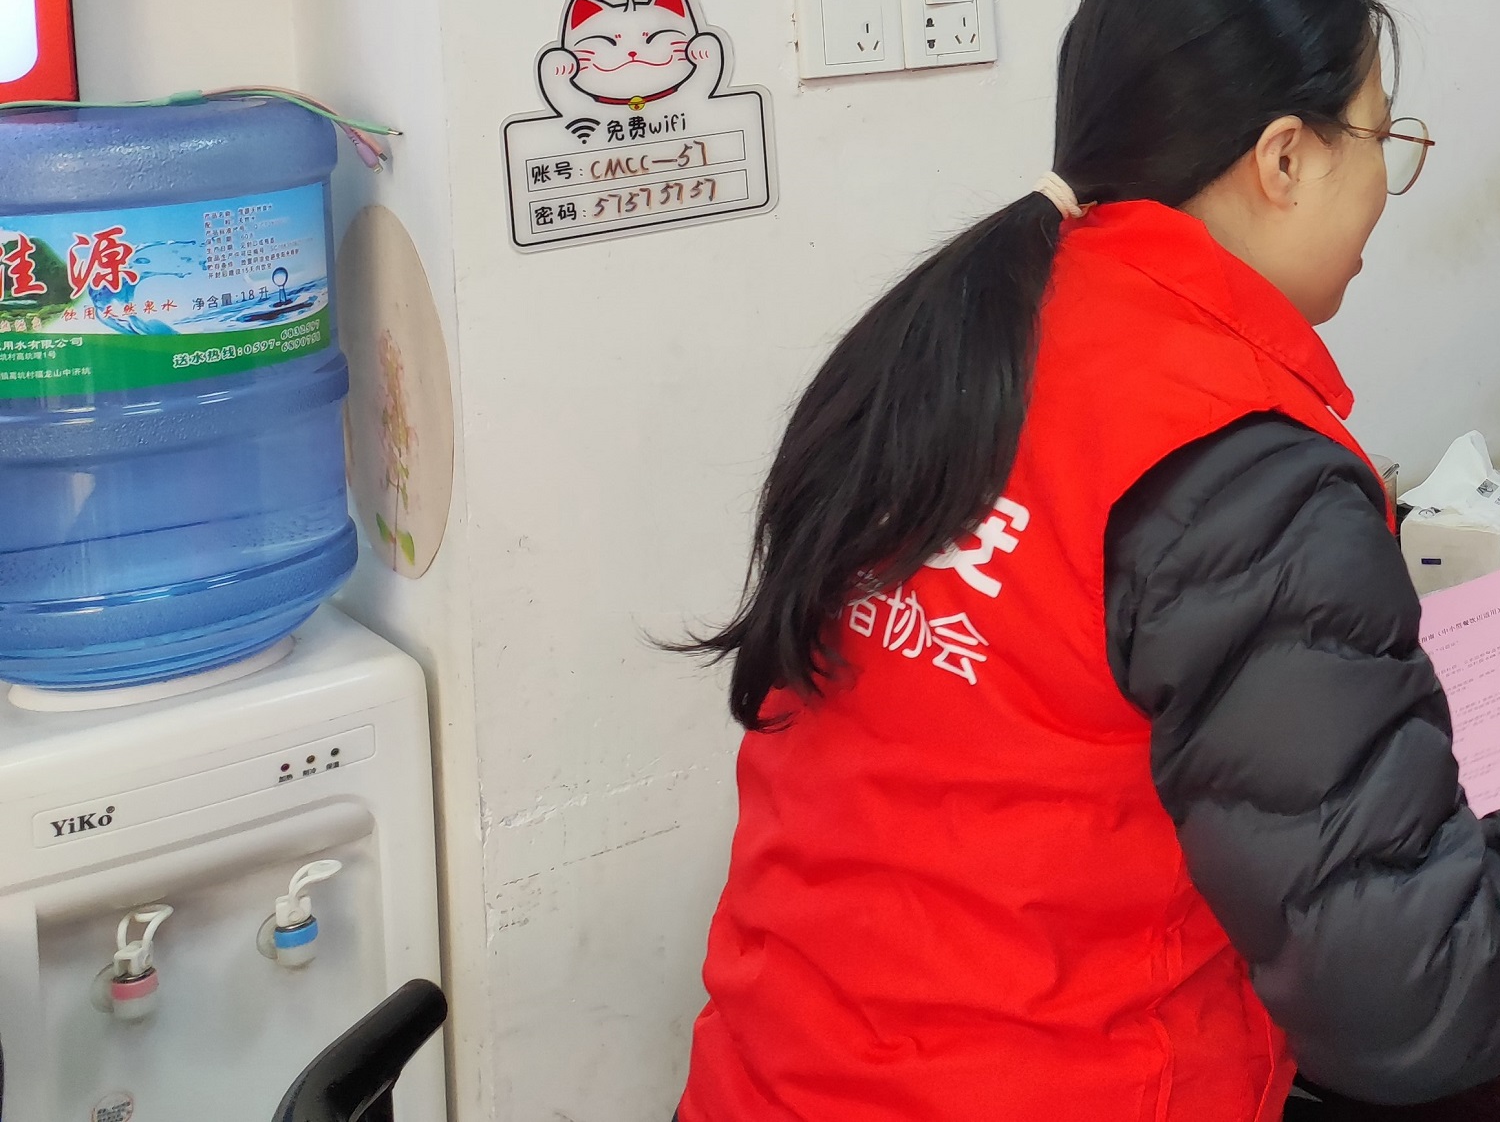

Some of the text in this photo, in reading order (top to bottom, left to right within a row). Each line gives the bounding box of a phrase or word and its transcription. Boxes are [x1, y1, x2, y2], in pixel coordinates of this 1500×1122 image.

[606, 114, 688, 143] 免费wifi
[61, 299, 178, 321] 饮用天然泉水
[0, 336, 83, 352] 用水有限公司
[50, 811, 113, 839] YiKo
